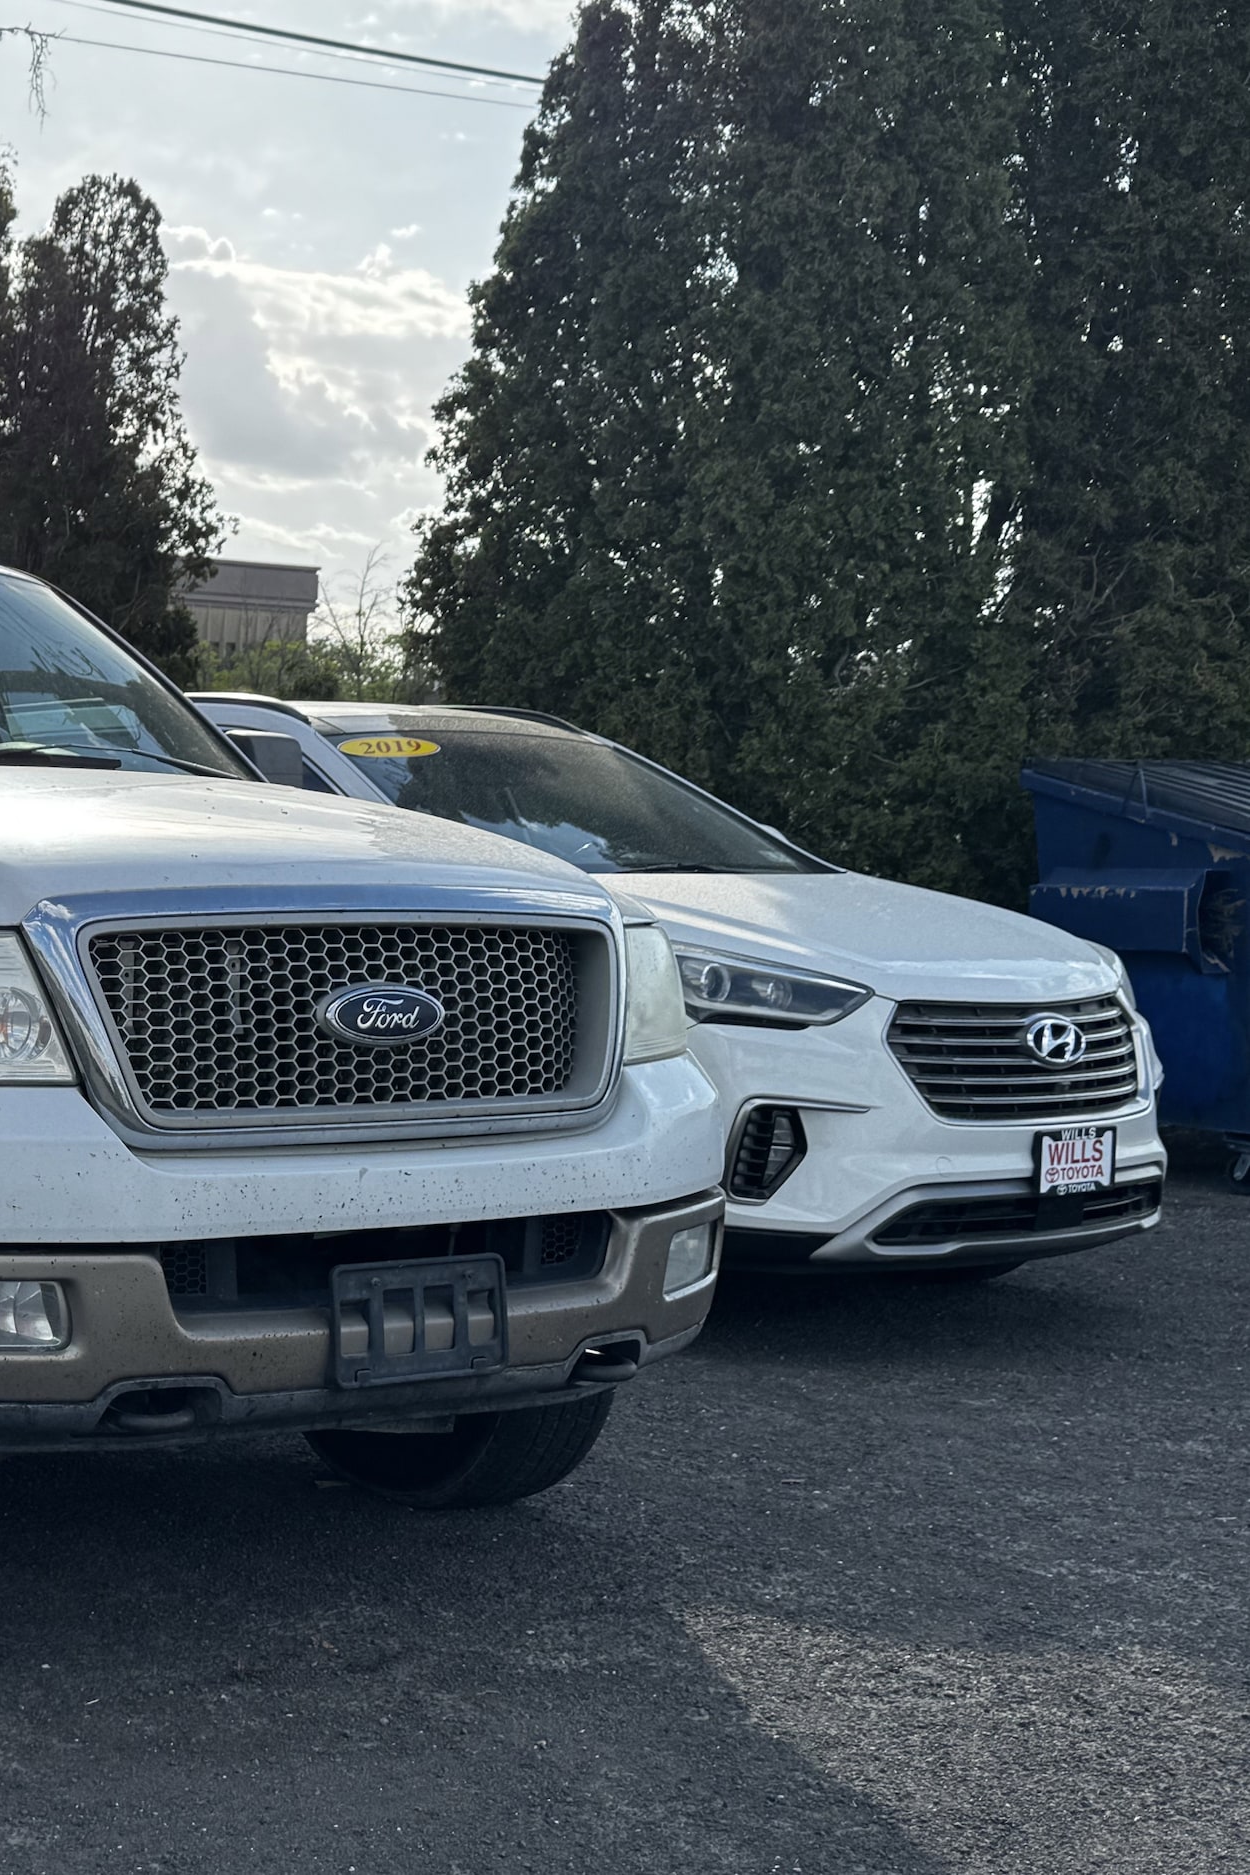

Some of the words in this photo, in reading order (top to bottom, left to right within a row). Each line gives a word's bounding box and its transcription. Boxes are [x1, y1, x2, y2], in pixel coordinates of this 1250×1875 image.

[358, 739, 421, 754] 2019
[357, 997, 420, 1029] Ford
[1061, 1127, 1097, 1140] WILLS
[1048, 1139, 1103, 1166] WILLS
[1060, 1164, 1104, 1180] TOYOTA
[1068, 1182, 1096, 1193] TOYOTA
